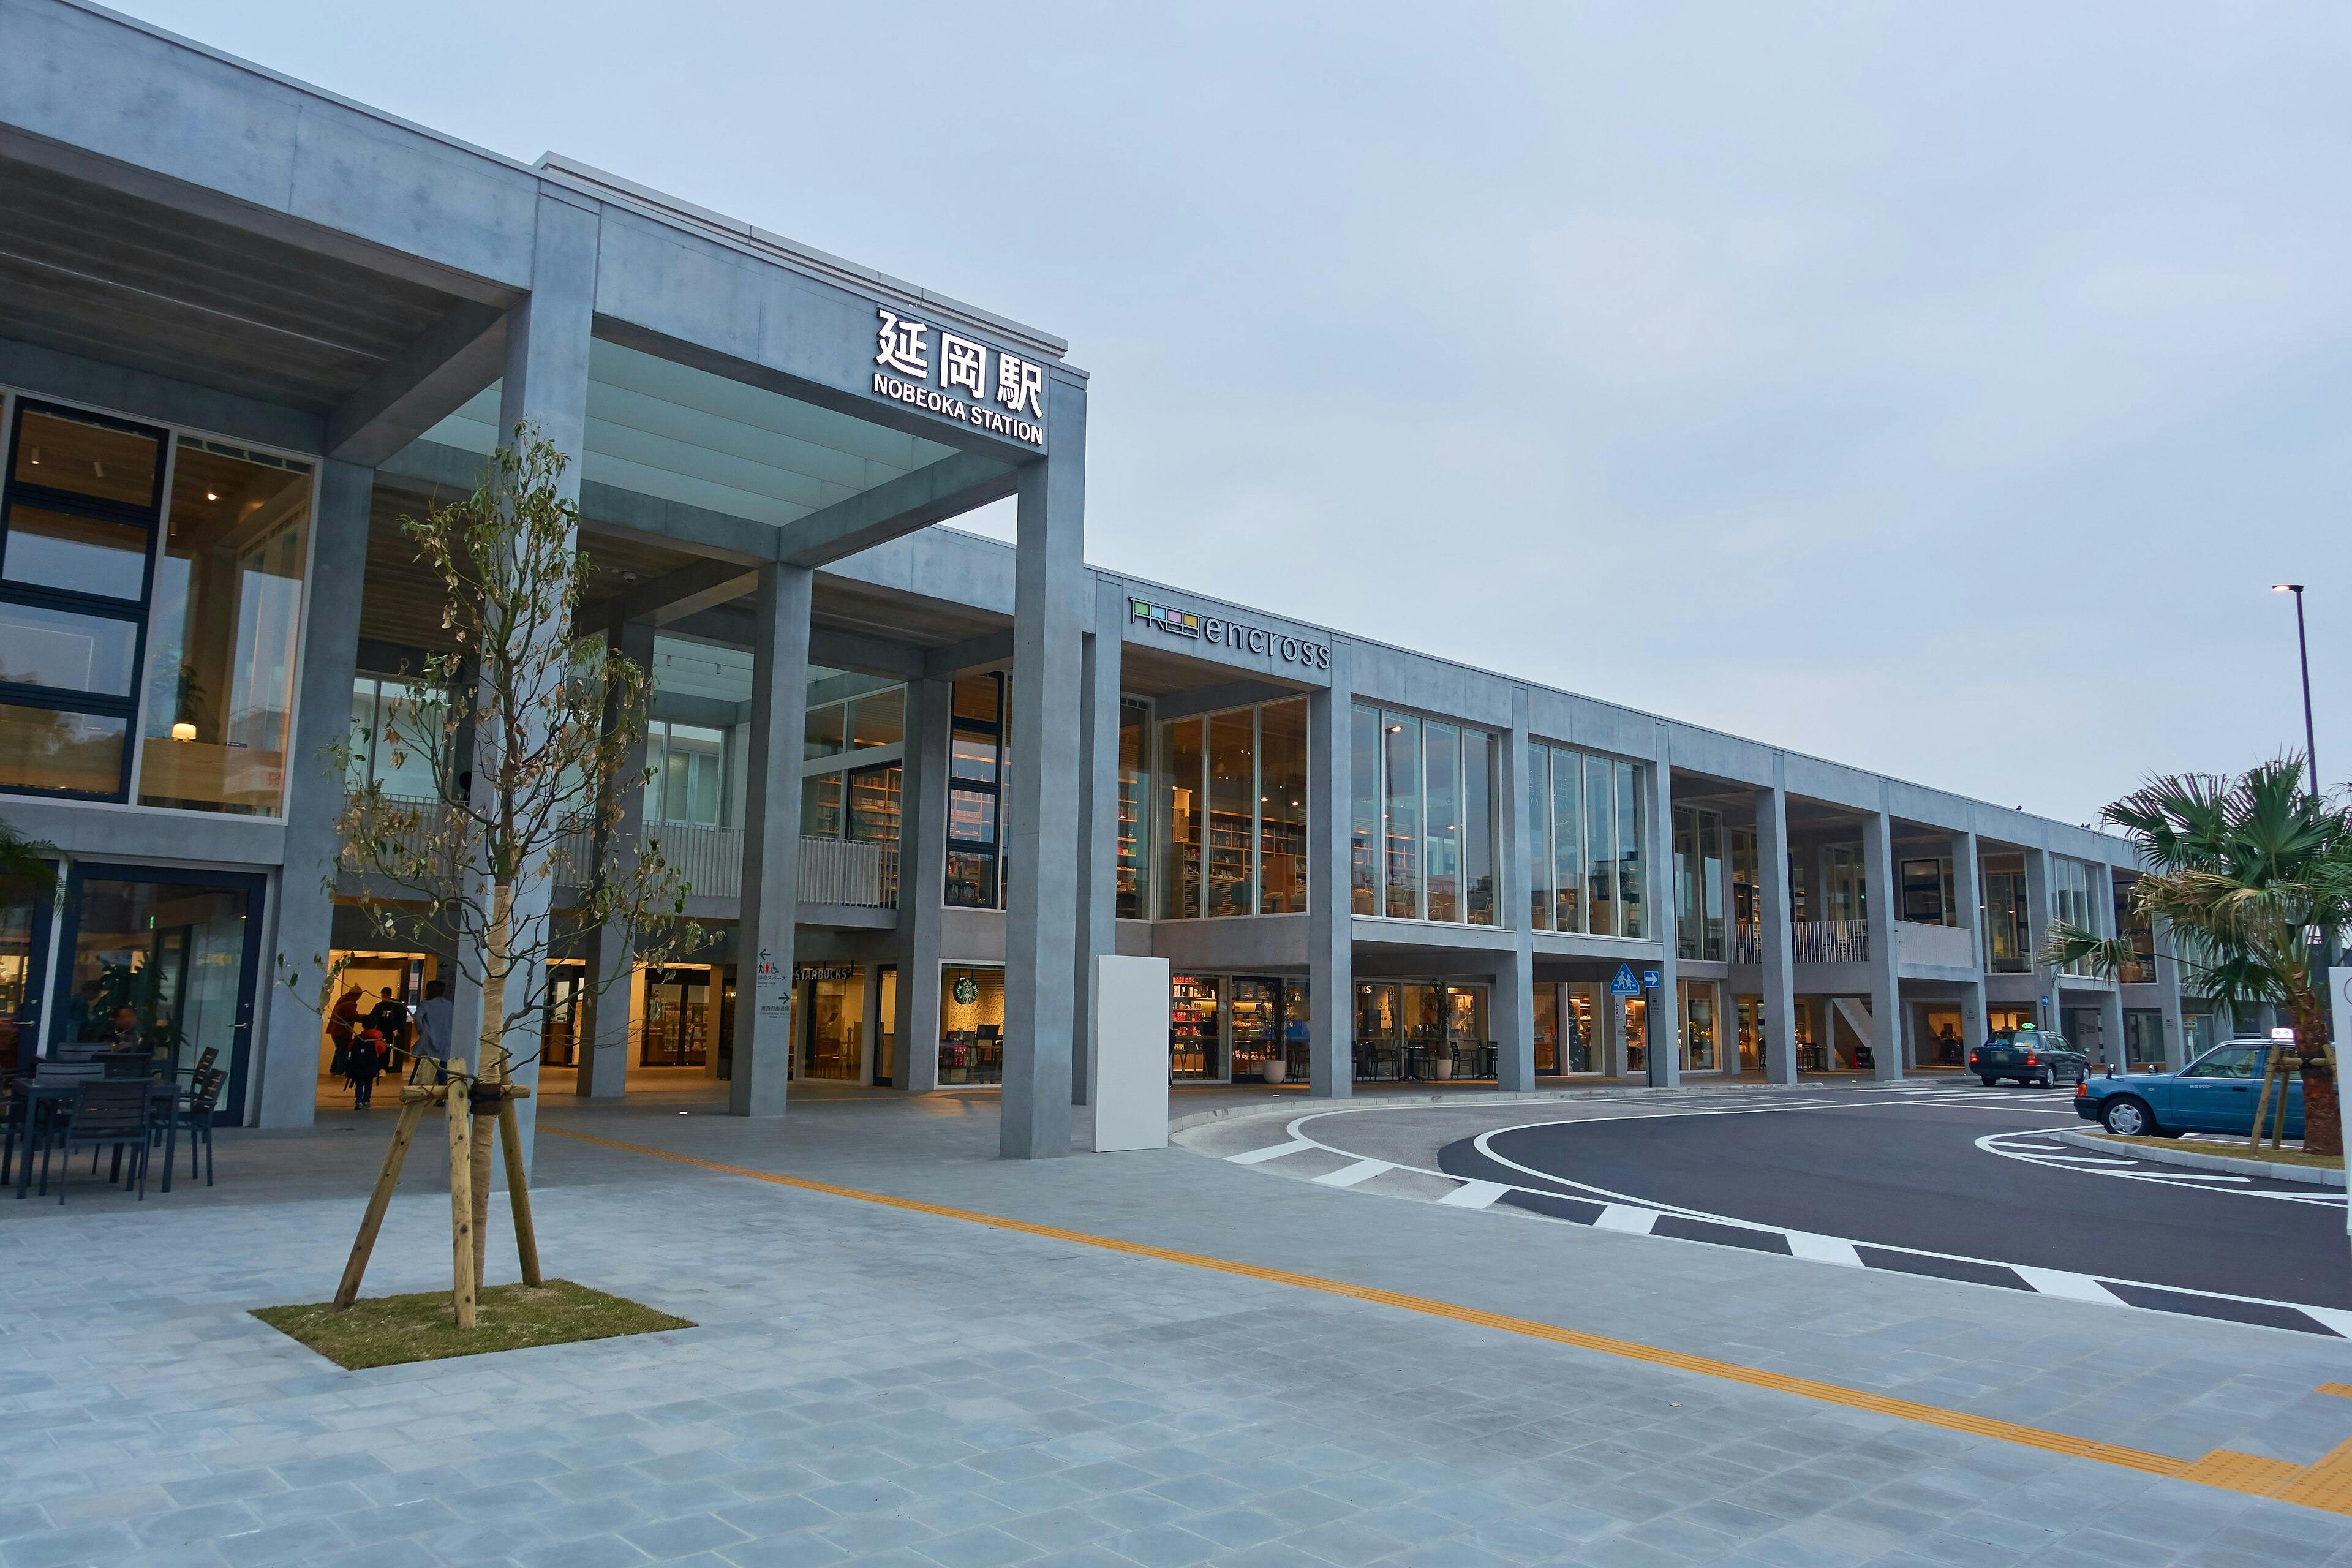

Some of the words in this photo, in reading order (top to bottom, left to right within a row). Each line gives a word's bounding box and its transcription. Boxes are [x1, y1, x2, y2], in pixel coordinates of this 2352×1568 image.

[874, 309, 1043, 419] 延岡駅
[873, 372, 966, 421] NOBEOKA
[970, 406, 1043, 446] STATION
[1204, 617, 1330, 669] encross
[795, 968, 846, 980] STARBUCKS
